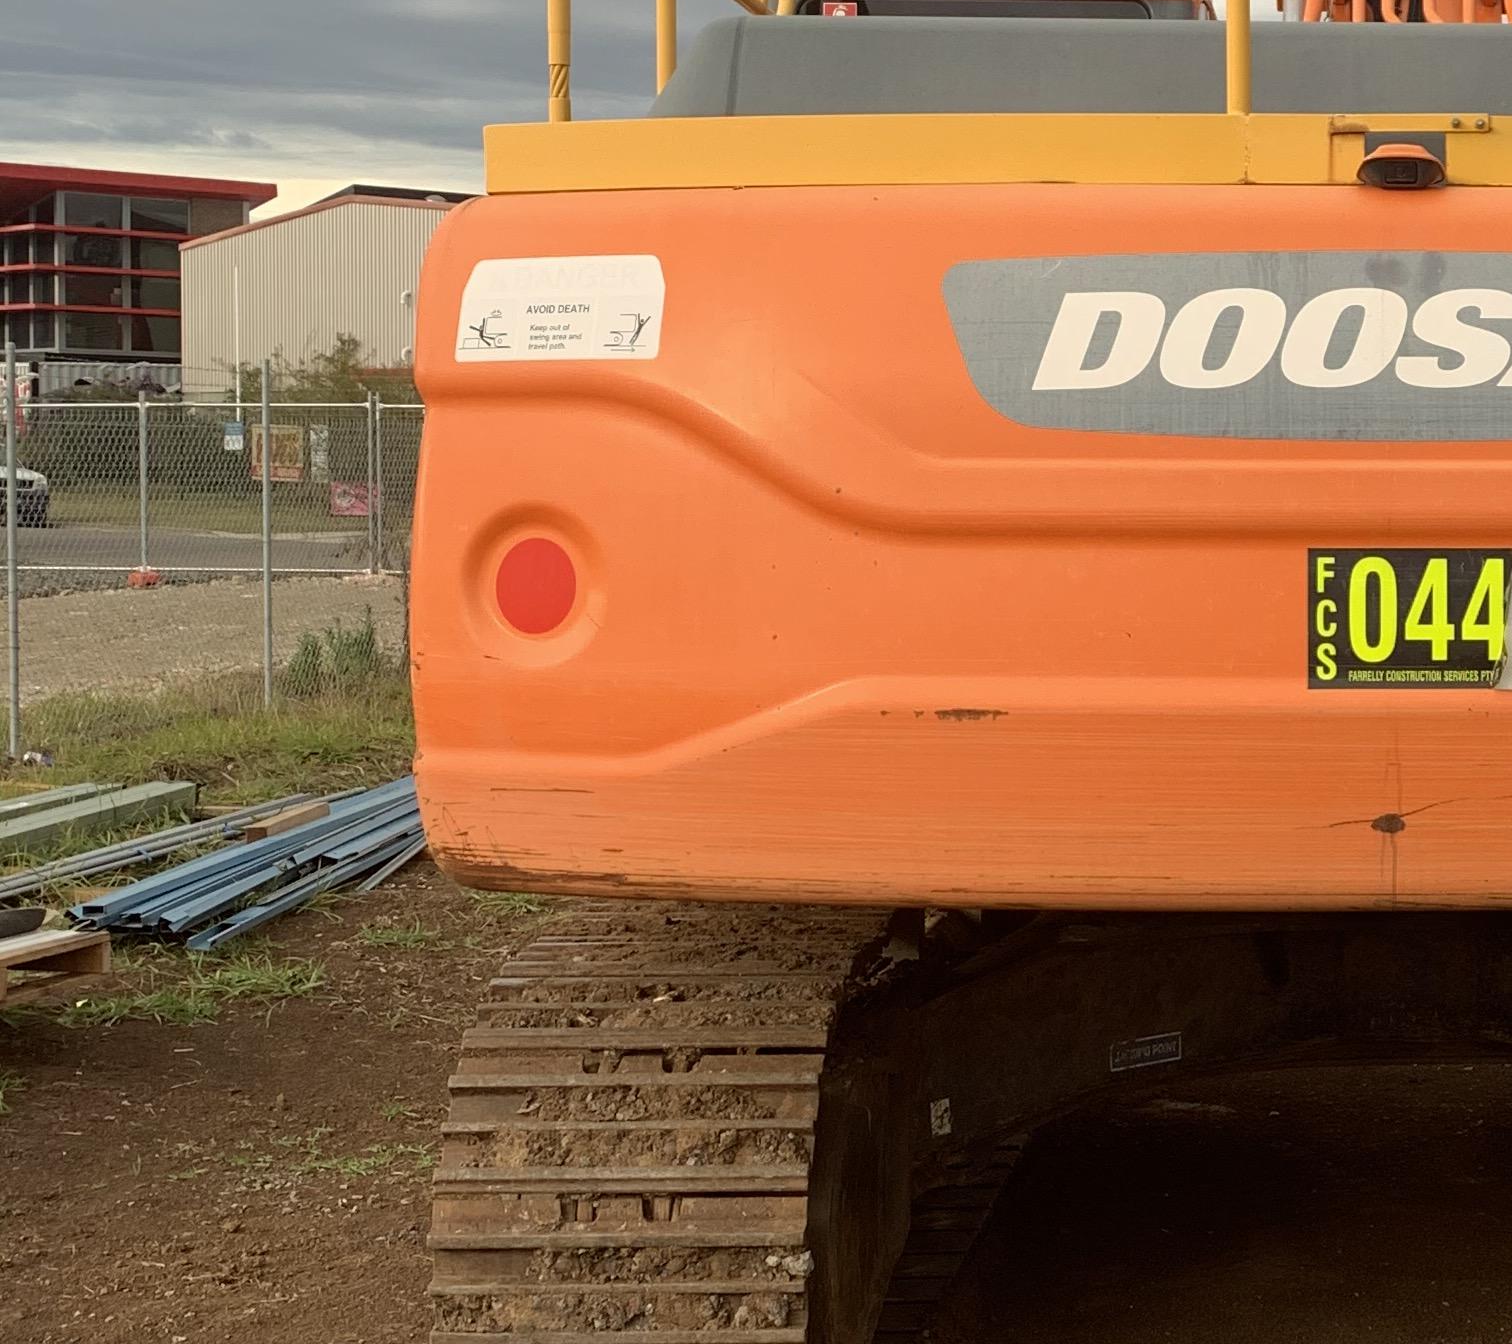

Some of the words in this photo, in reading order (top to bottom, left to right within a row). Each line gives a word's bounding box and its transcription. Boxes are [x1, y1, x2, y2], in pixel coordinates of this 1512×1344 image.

[526, 304, 556, 314] AVOID
[557, 303, 590, 314] DEATH
[529, 324, 548, 333] Keep
[1348, 556, 1505, 663] 044
[1316, 556, 1338, 681] FCS
[1349, 670, 1384, 682] FARRELLY
[1386, 670, 1442, 682] CONSTRUCTION
[1443, 670, 1479, 682] SERVICES
